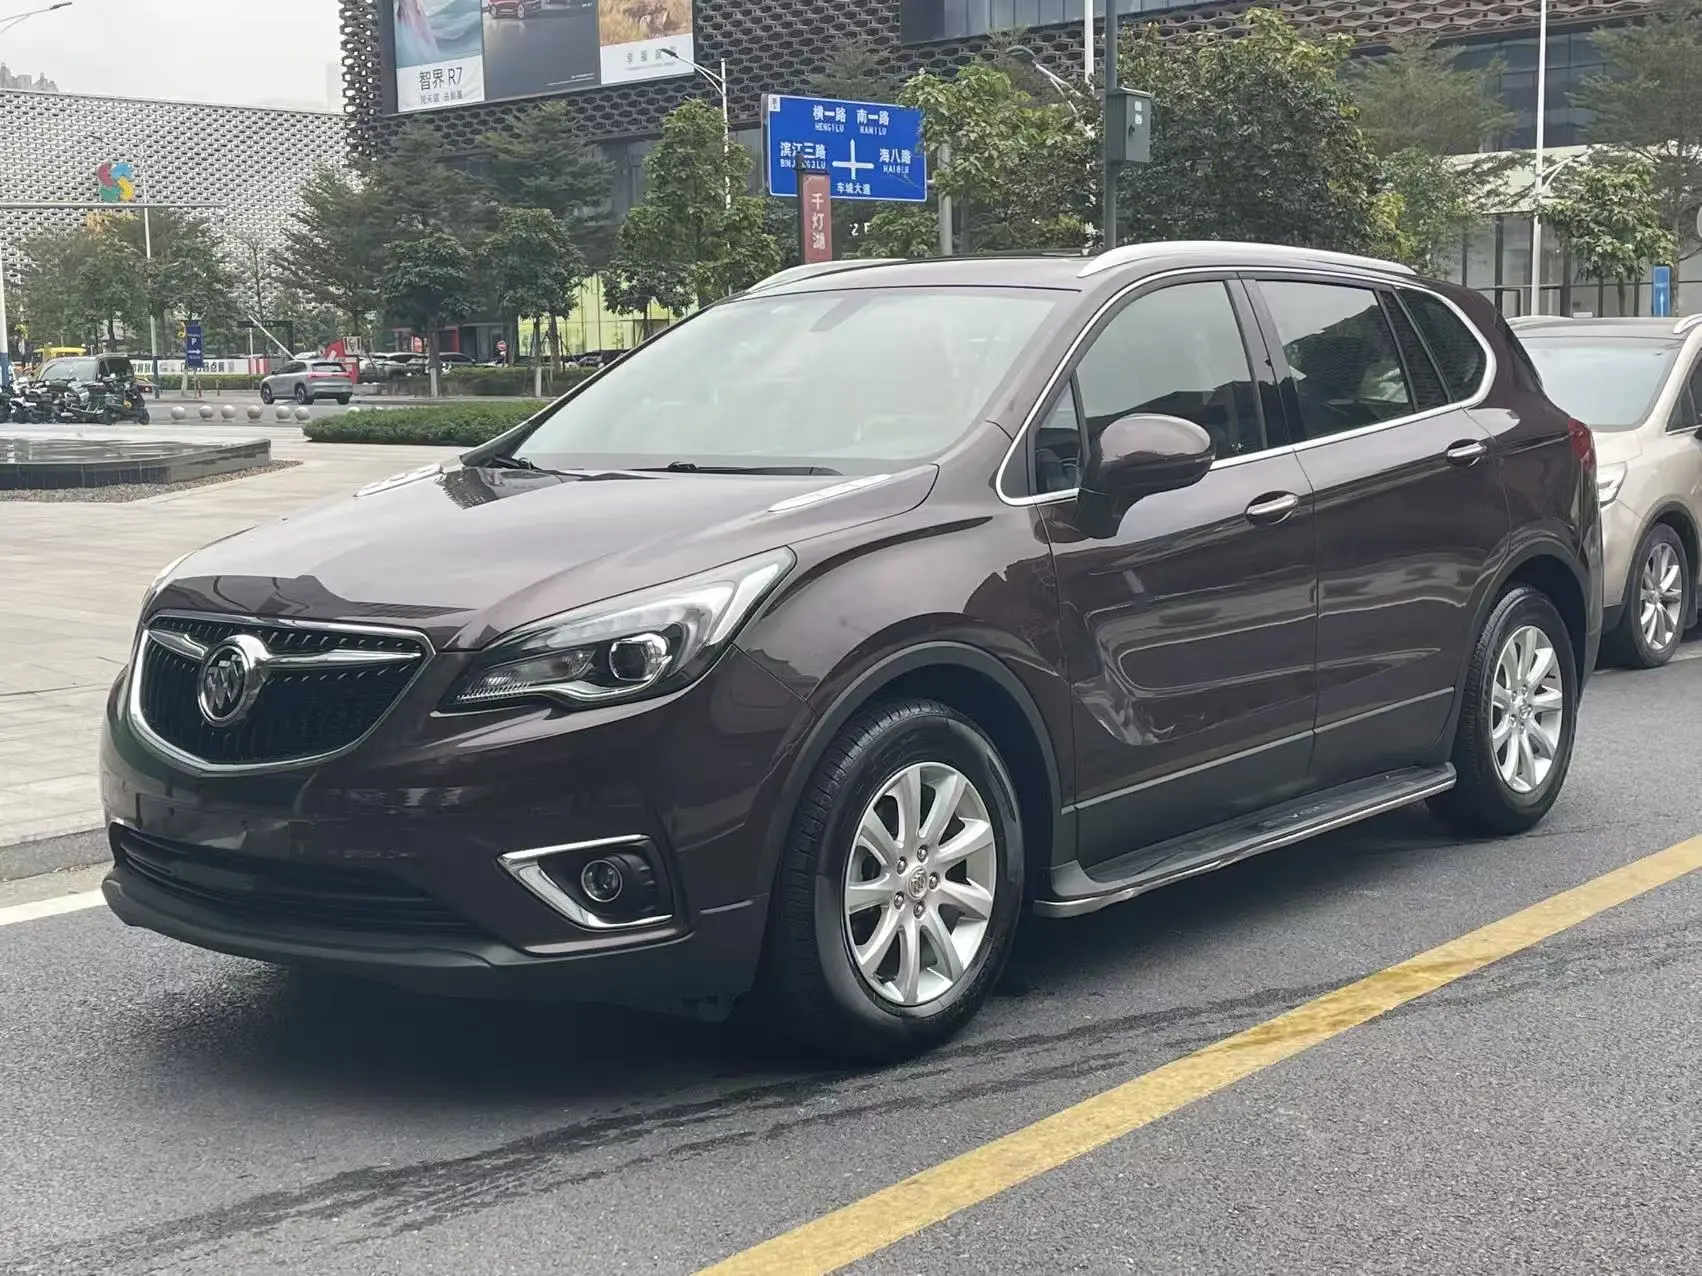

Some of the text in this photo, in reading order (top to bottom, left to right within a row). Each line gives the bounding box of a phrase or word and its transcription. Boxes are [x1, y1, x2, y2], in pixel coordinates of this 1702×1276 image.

[419, 66, 463, 91] 智界 R7
[813, 104, 890, 126] 横一路 南一路
[879, 148, 912, 165] 海八路
[836, 182, 871, 195] 车城大道
[811, 192, 826, 250] 千灯湖
